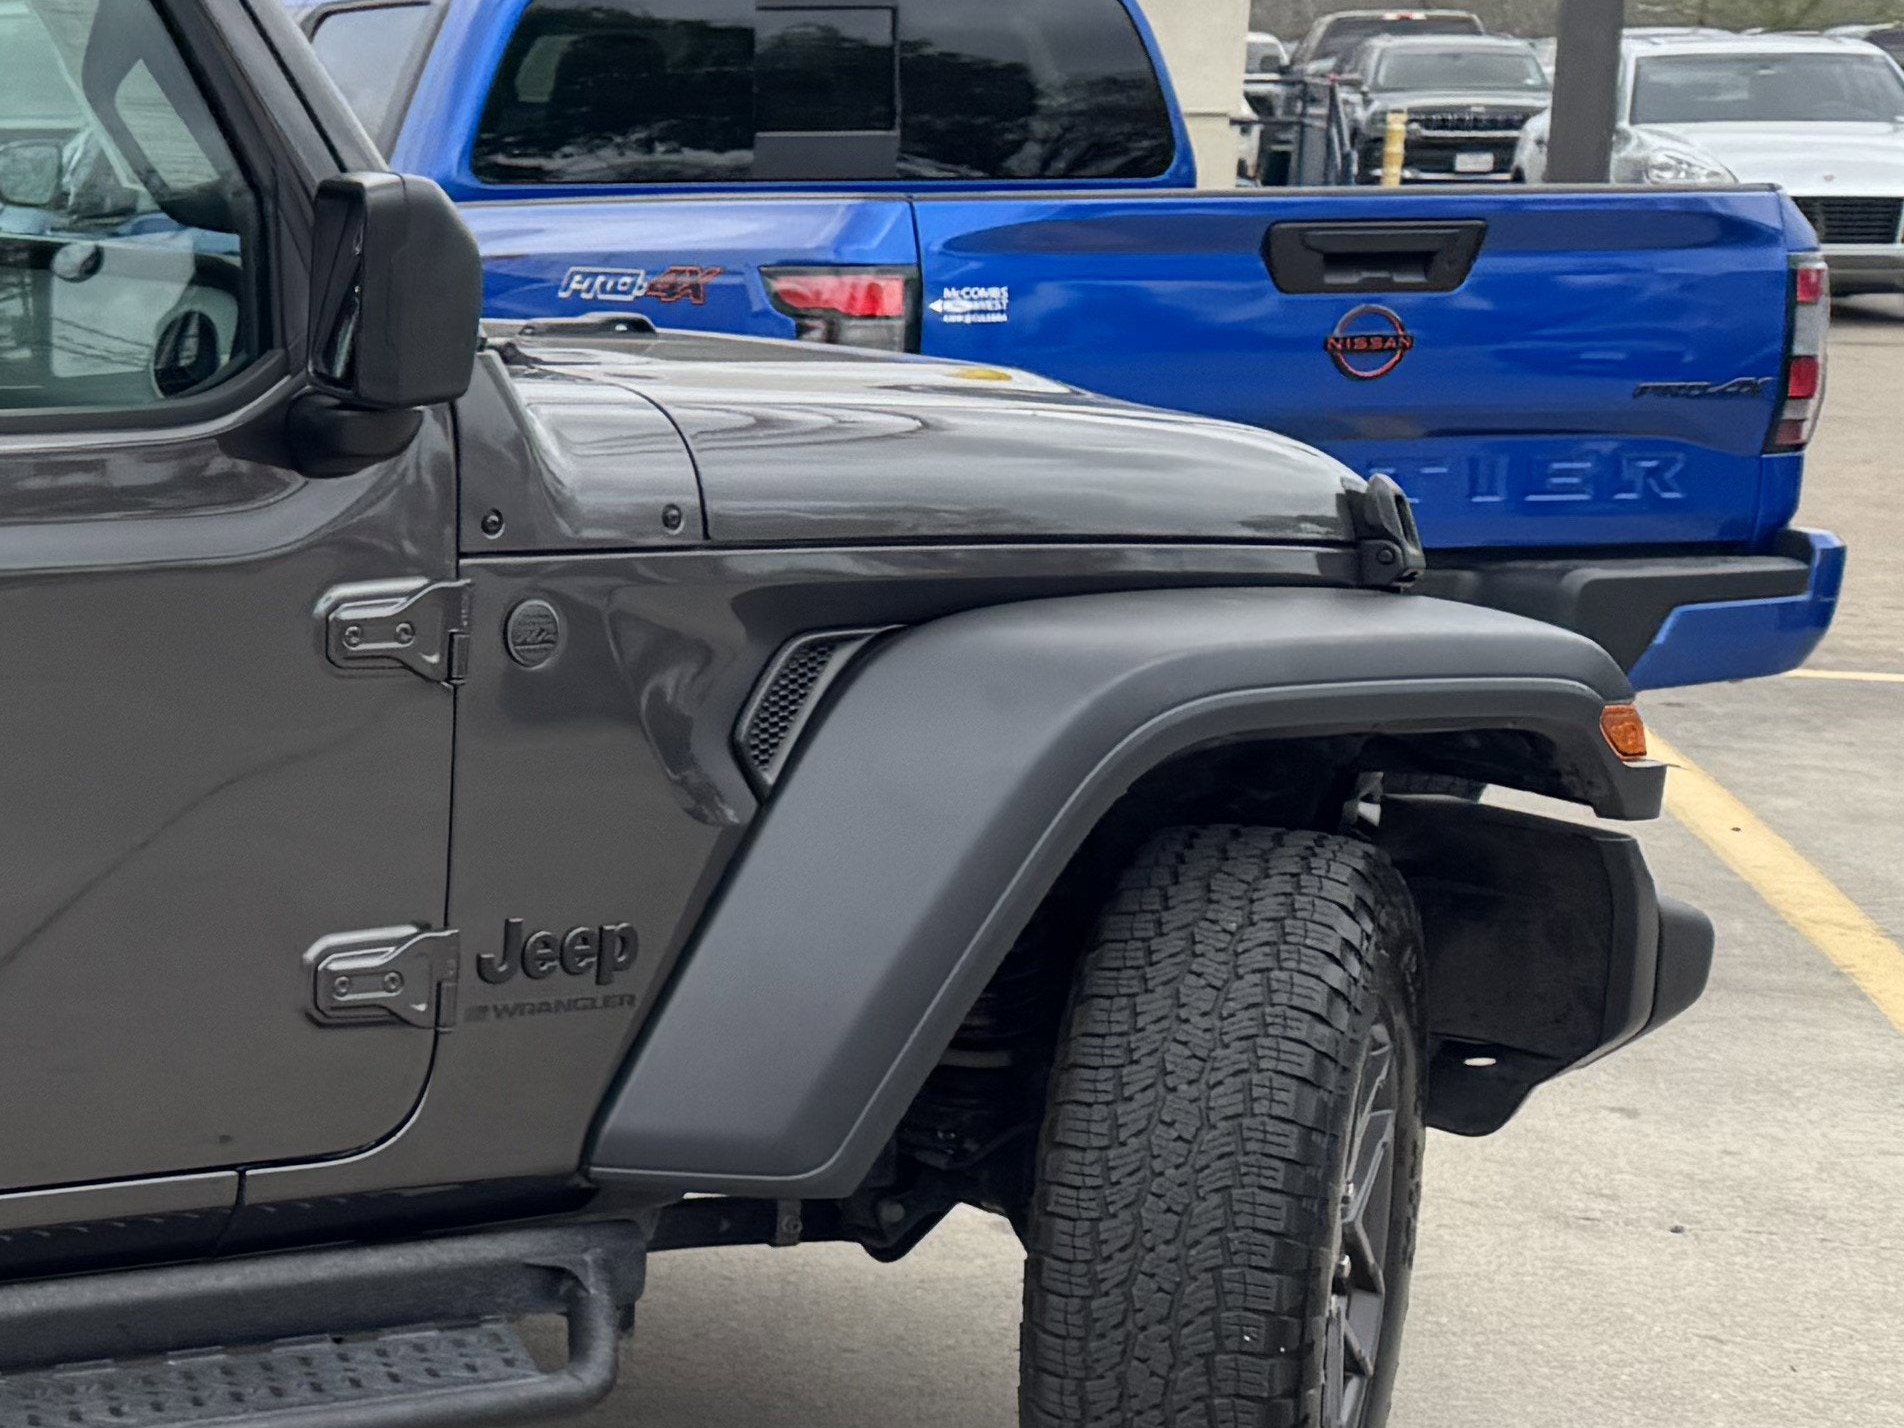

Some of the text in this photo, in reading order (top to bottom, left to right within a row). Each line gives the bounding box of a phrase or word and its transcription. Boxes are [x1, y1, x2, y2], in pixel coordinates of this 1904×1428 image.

[1327, 336, 1412, 351] NISSAN
[476, 917, 640, 986] Jeep
[493, 993, 637, 1020] WRANGLER
